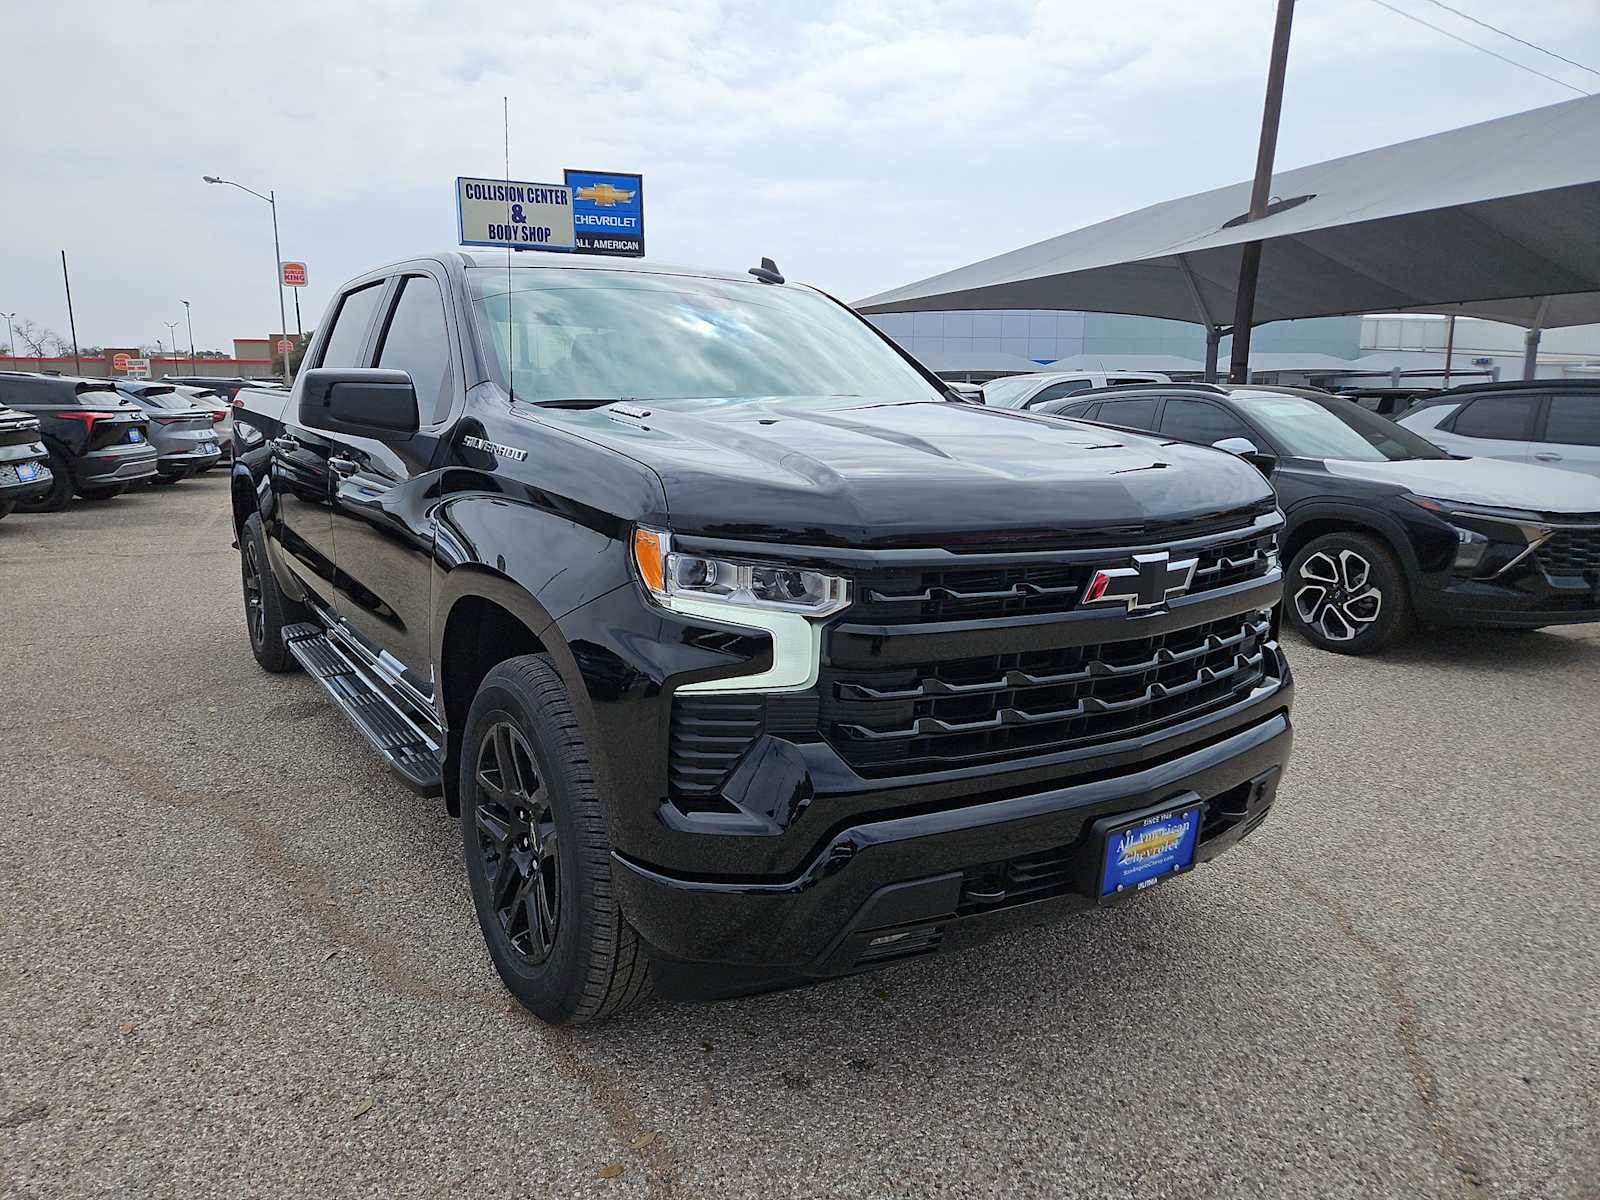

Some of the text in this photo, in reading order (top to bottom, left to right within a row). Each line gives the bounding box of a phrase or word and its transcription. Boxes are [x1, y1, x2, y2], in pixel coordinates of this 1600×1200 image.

[466, 184, 568, 205] COLLISION CENTER
[512, 204, 526, 223] &
[575, 214, 636, 227] CHEVROLET
[488, 223, 551, 242] BODY SHOP
[576, 238, 639, 250] ALL AMERICAN
[462, 435, 527, 461] SILVERADO
[1140, 821, 1190, 842] American
